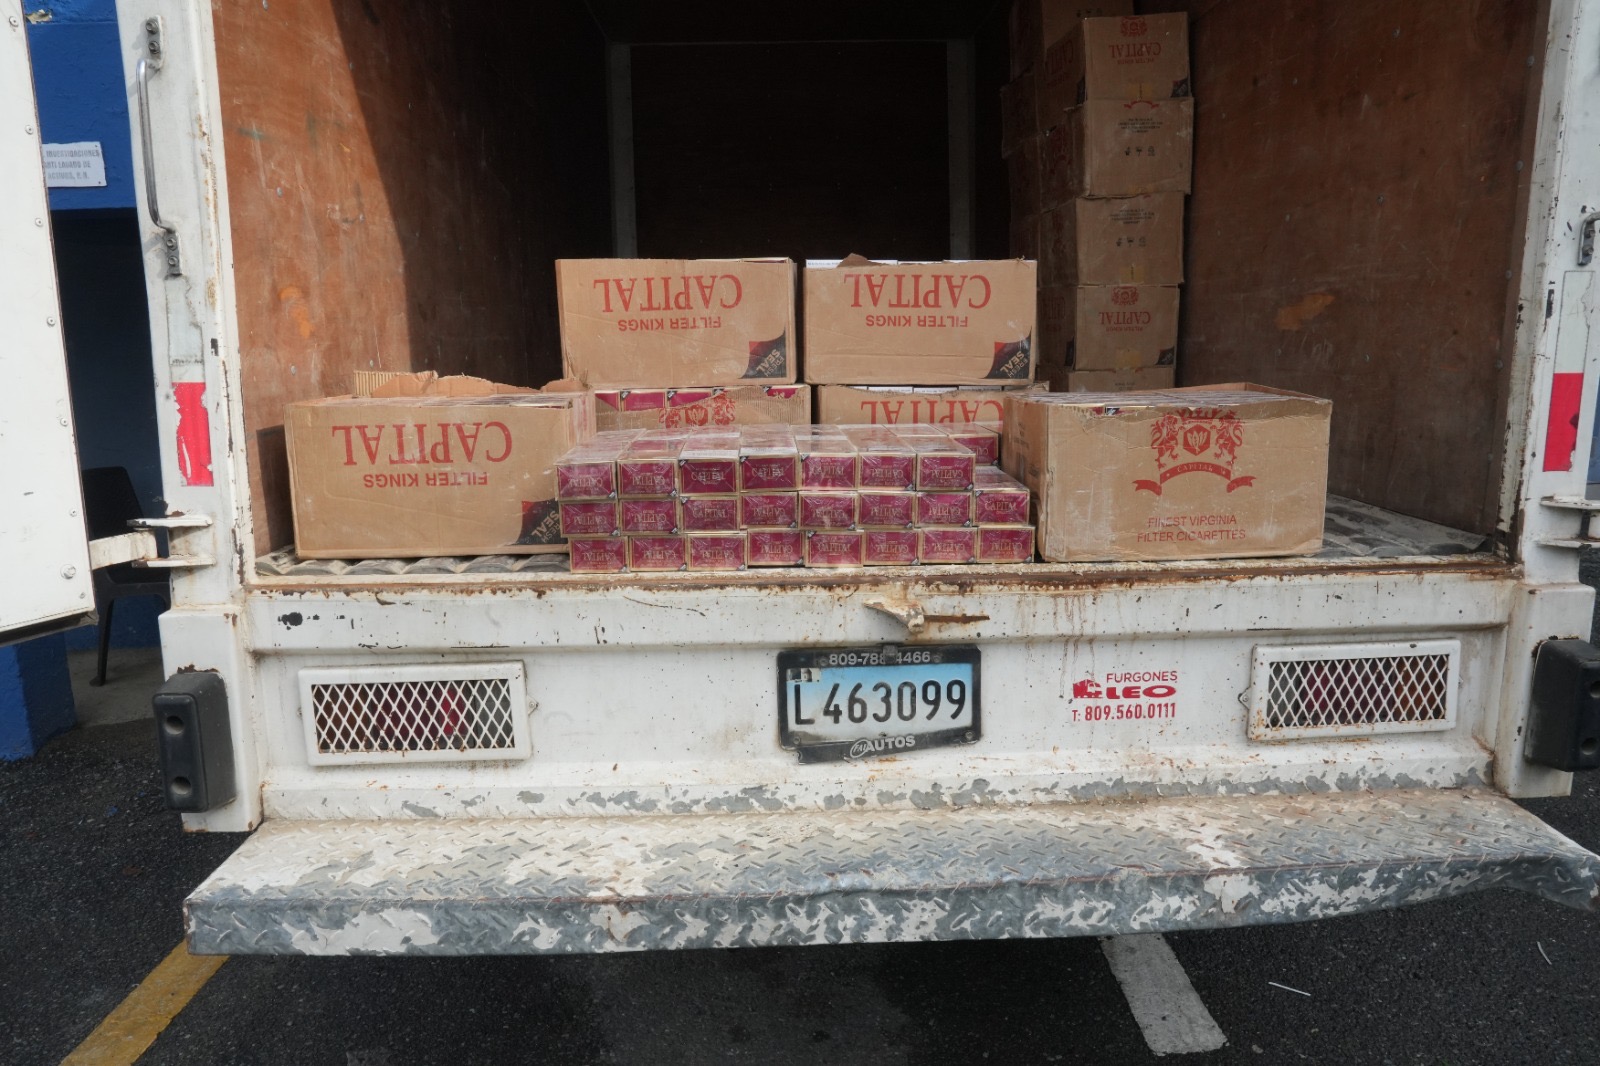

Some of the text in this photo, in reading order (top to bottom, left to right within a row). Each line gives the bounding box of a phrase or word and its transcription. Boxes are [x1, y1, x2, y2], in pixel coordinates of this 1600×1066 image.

[1109, 42, 1162, 59] CAPITAL
[593, 274, 743, 313] CAPITAL
[843, 274, 992, 309] CAPITAL
[618, 316, 722, 332] FILTER KINGS
[865, 314, 968, 328] FILTER KINGS
[1099, 311, 1151, 325] CAPITAL
[755, 349, 781, 372] SEAL
[764, 357, 785, 377] FRESH
[1000, 350, 1025, 373] SEAL
[1007, 358, 1028, 378] FRESH
[332, 421, 513, 466] CAPITAL
[363, 471, 488, 489] FILTER KINGS
[531, 511, 559, 537] SEAL
[1148, 514, 1237, 528] FINEST VIRGINIA
[541, 522, 560, 543] RESH
[1137, 531, 1173, 543] FILTER
[1106, 671, 1178, 683] FURGONES
[1106, 685, 1176, 699] LEO
[794, 679, 966, 725] L463099
[1072, 703, 1176, 721] T: 809.560.0111
[864, 736, 916, 751] AUTOS
